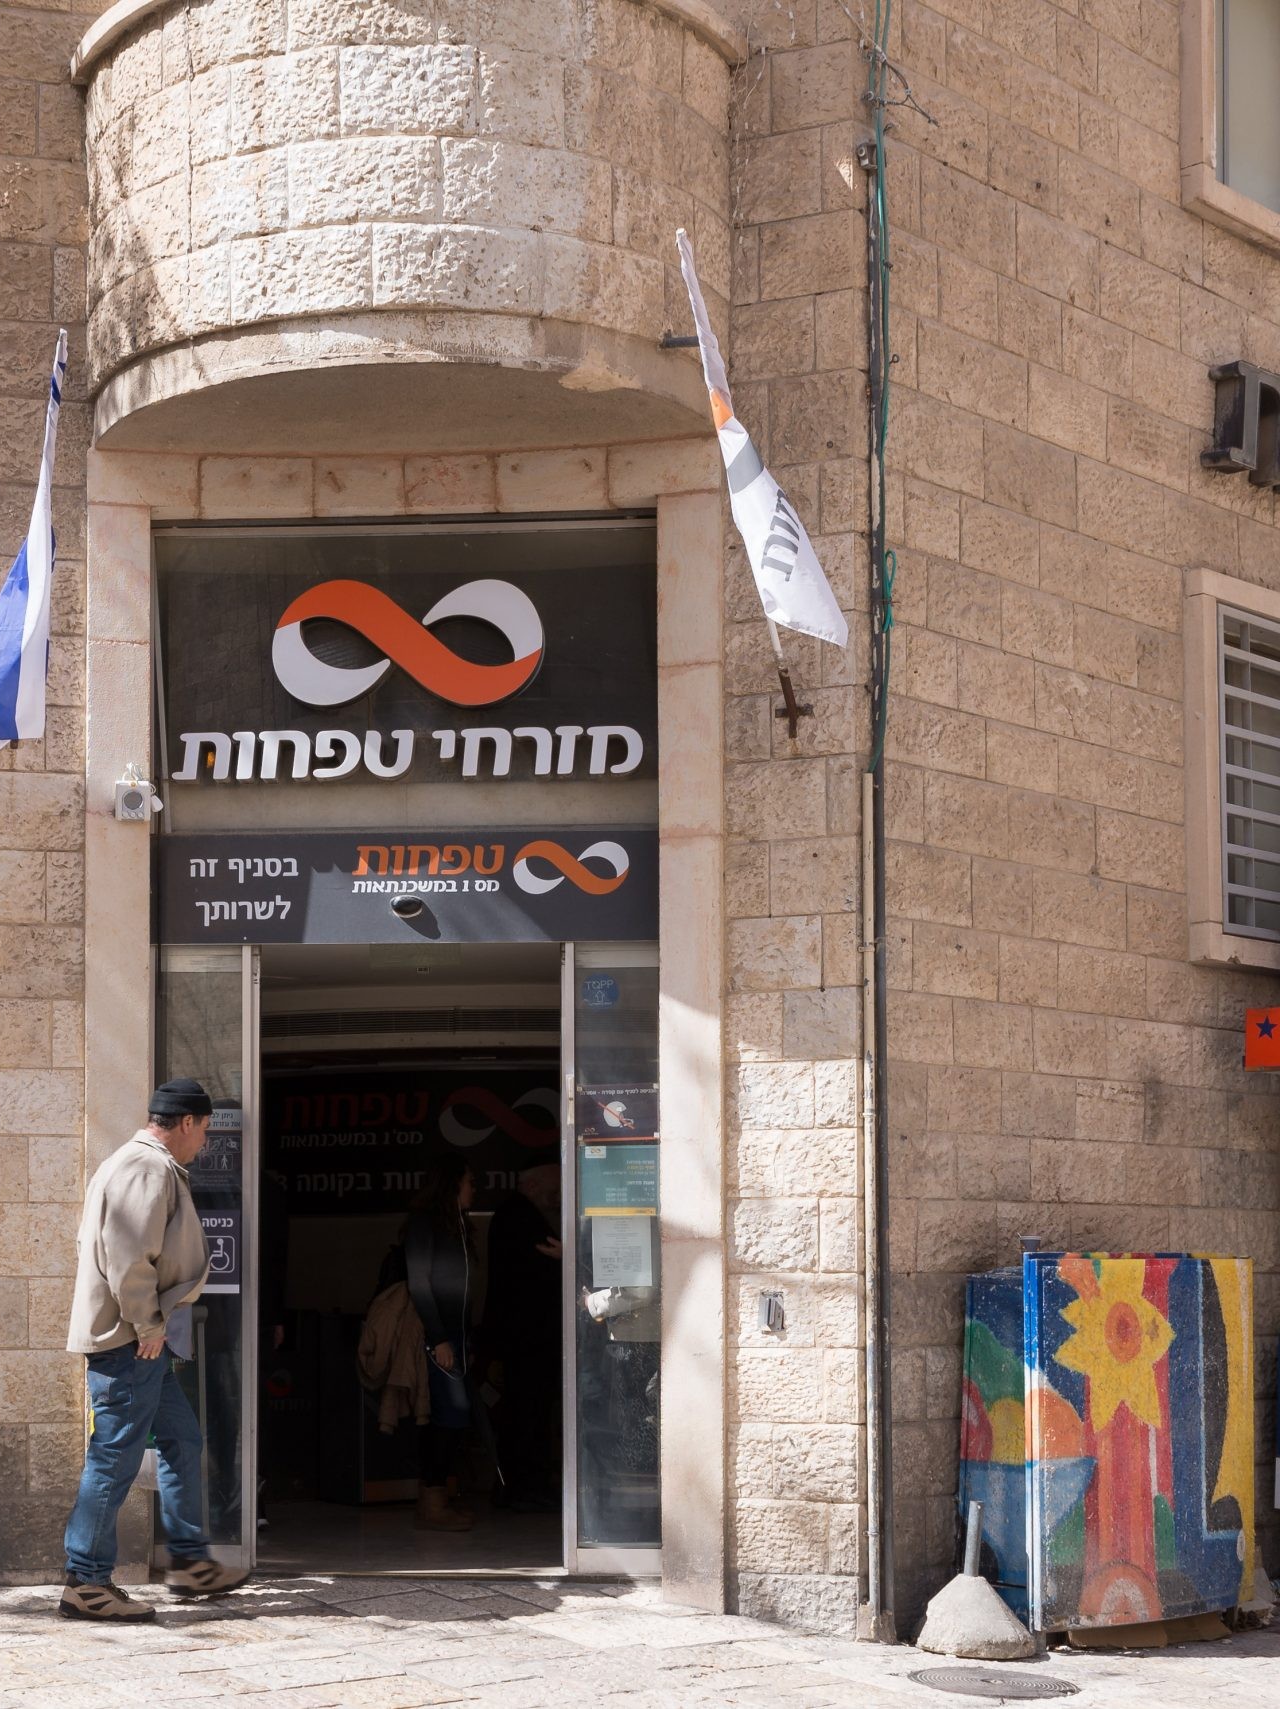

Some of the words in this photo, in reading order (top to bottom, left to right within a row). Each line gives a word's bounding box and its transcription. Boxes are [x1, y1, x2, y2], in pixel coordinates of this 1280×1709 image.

[171, 729, 415, 782] טפחות
[431, 725, 645, 778] מזרחי
[189, 858, 218, 878] זה
[227, 857, 300, 884] בסניף
[351, 844, 505, 876] טפחות
[351, 879, 457, 894] במשכנתאות
[195, 895, 291, 927] לשרותך
[280, 1090, 431, 1130] טפחות
[279, 1132, 378, 1149] במשכנתאות
[296, 1173, 372, 1198] בקומה
[201, 1217, 234, 1228] כניסה
